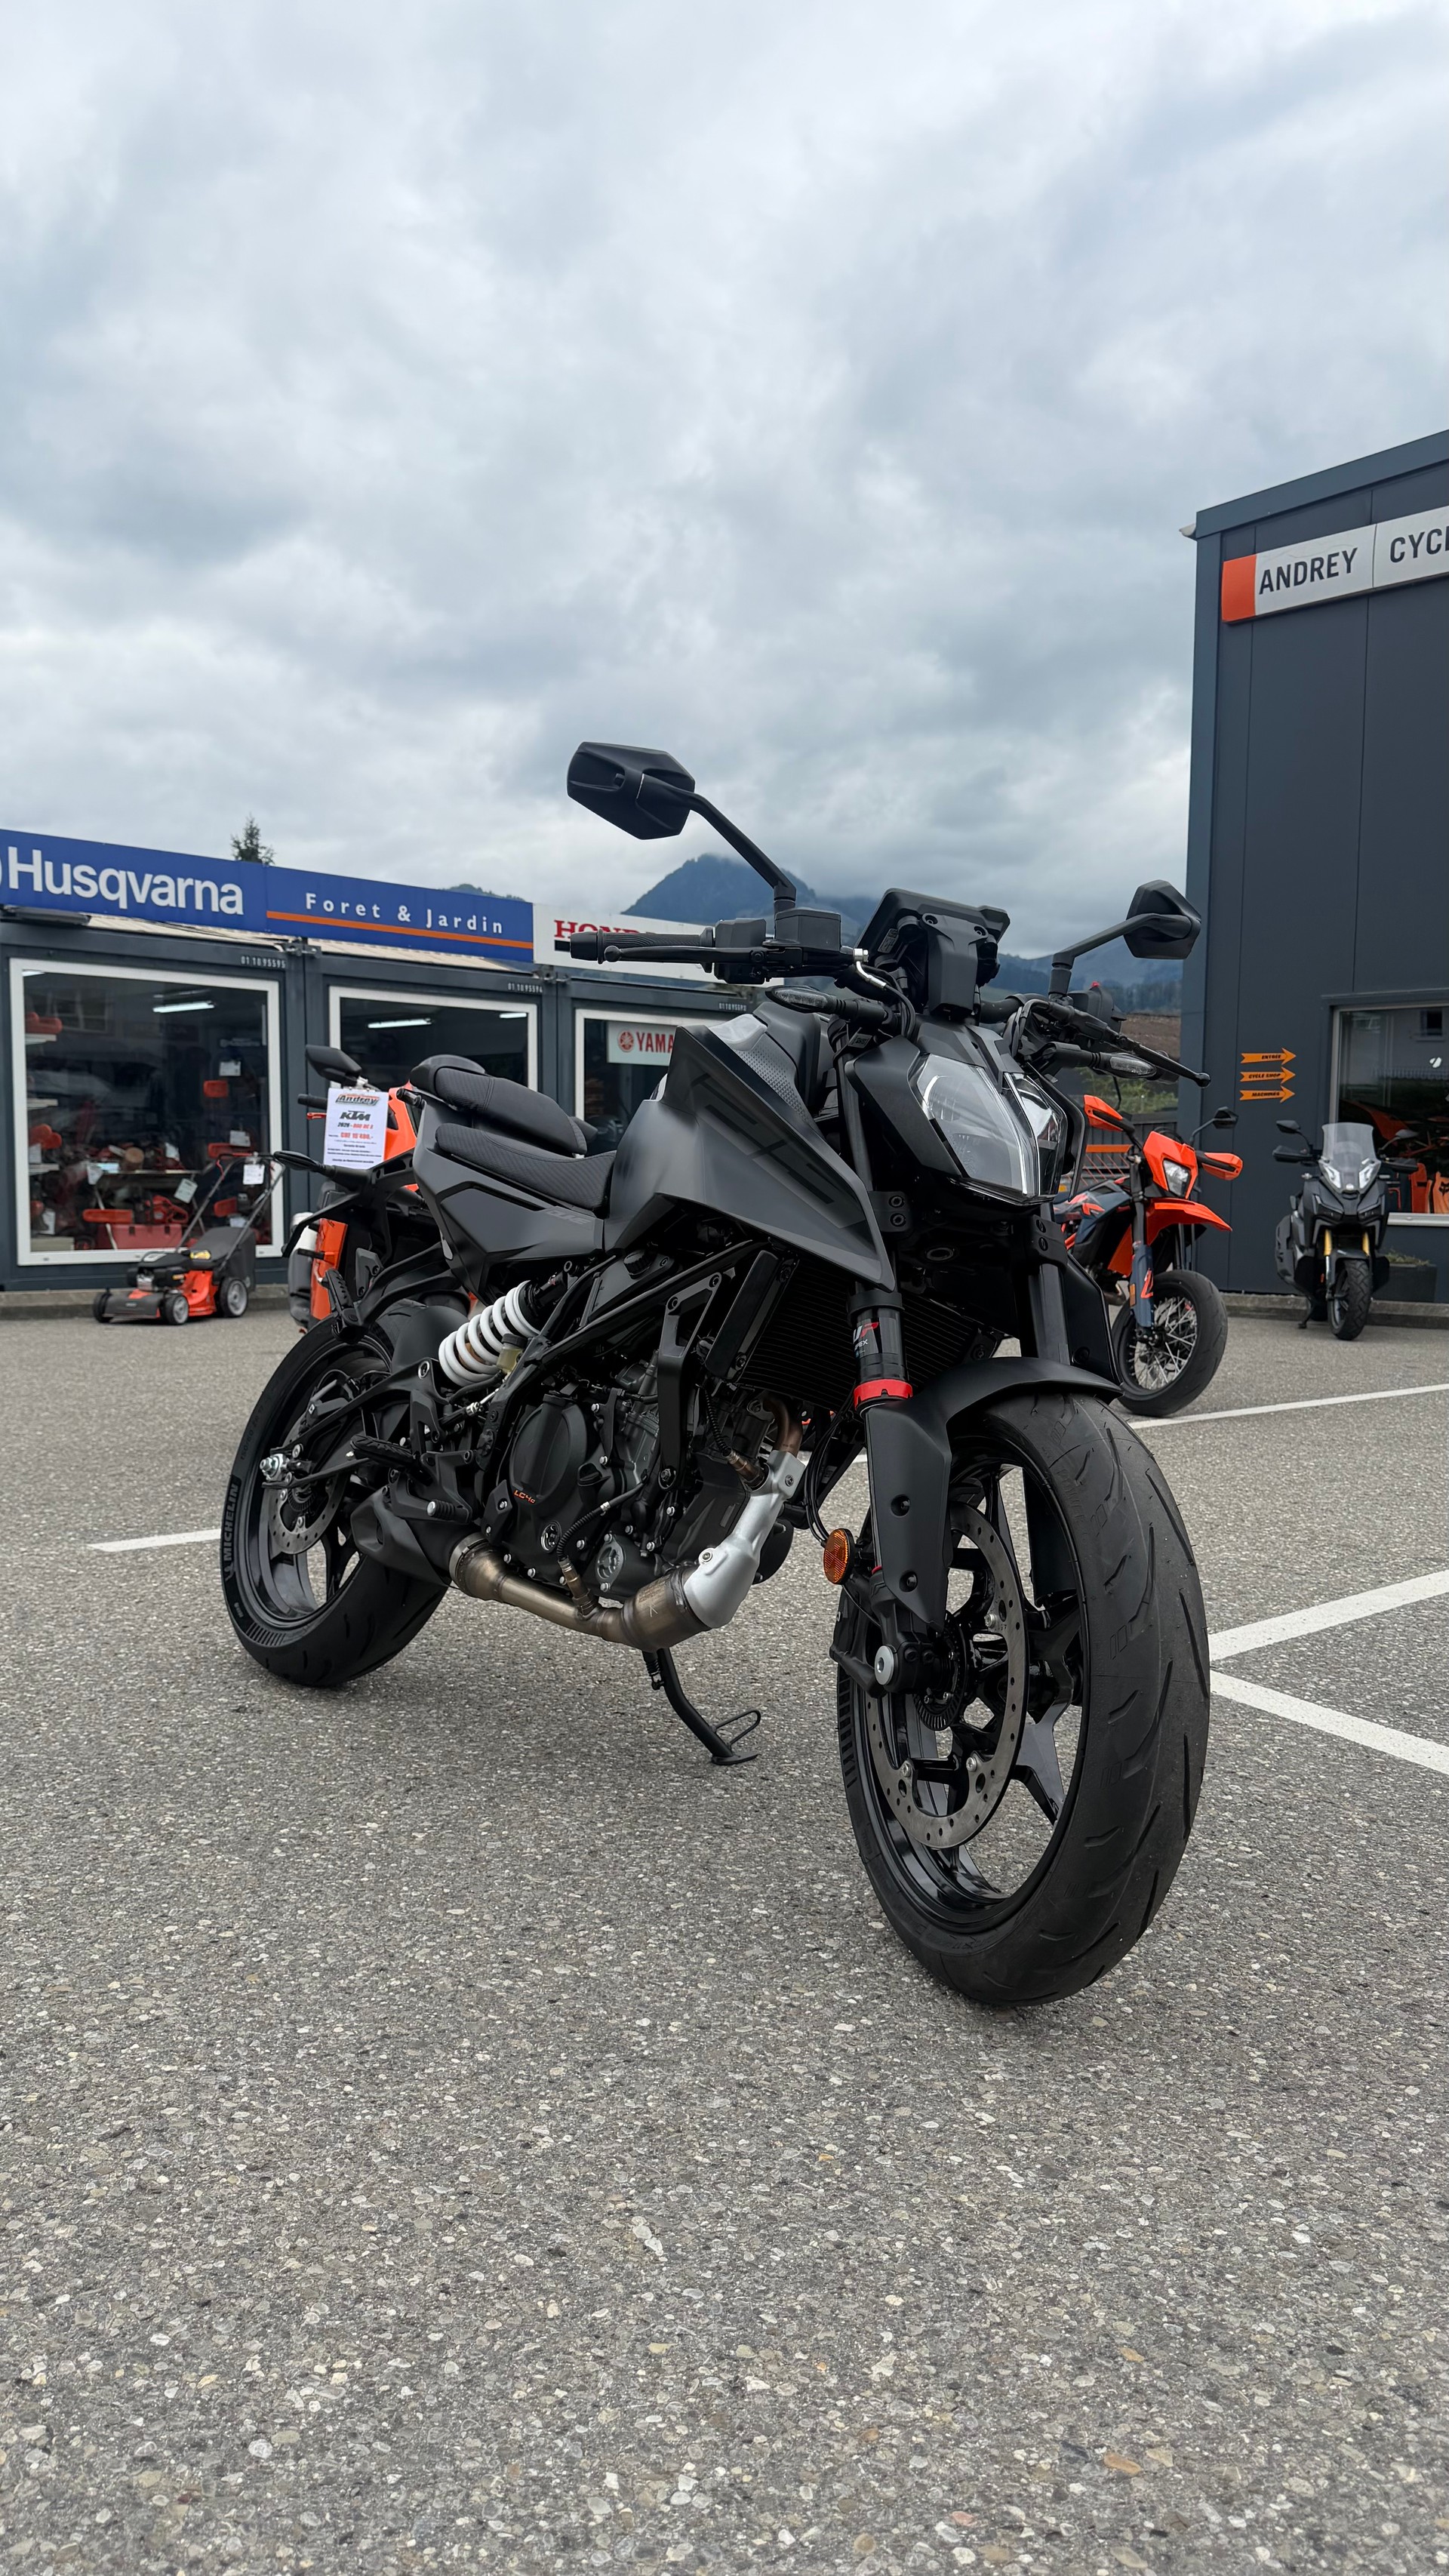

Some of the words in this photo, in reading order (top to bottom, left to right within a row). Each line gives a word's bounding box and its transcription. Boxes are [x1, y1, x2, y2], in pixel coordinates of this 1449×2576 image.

[1259, 547, 1358, 595] ANDREY
[8, 846, 244, 916] Husqvarna
[306, 892, 380, 919] Foret
[397, 904, 411, 922] &
[426, 908, 503, 934] Jardin
[338, 1094, 378, 1106] Andrey
[340, 1110, 371, 1122] KTM
[223, 1483, 239, 1562] MICHELIN
